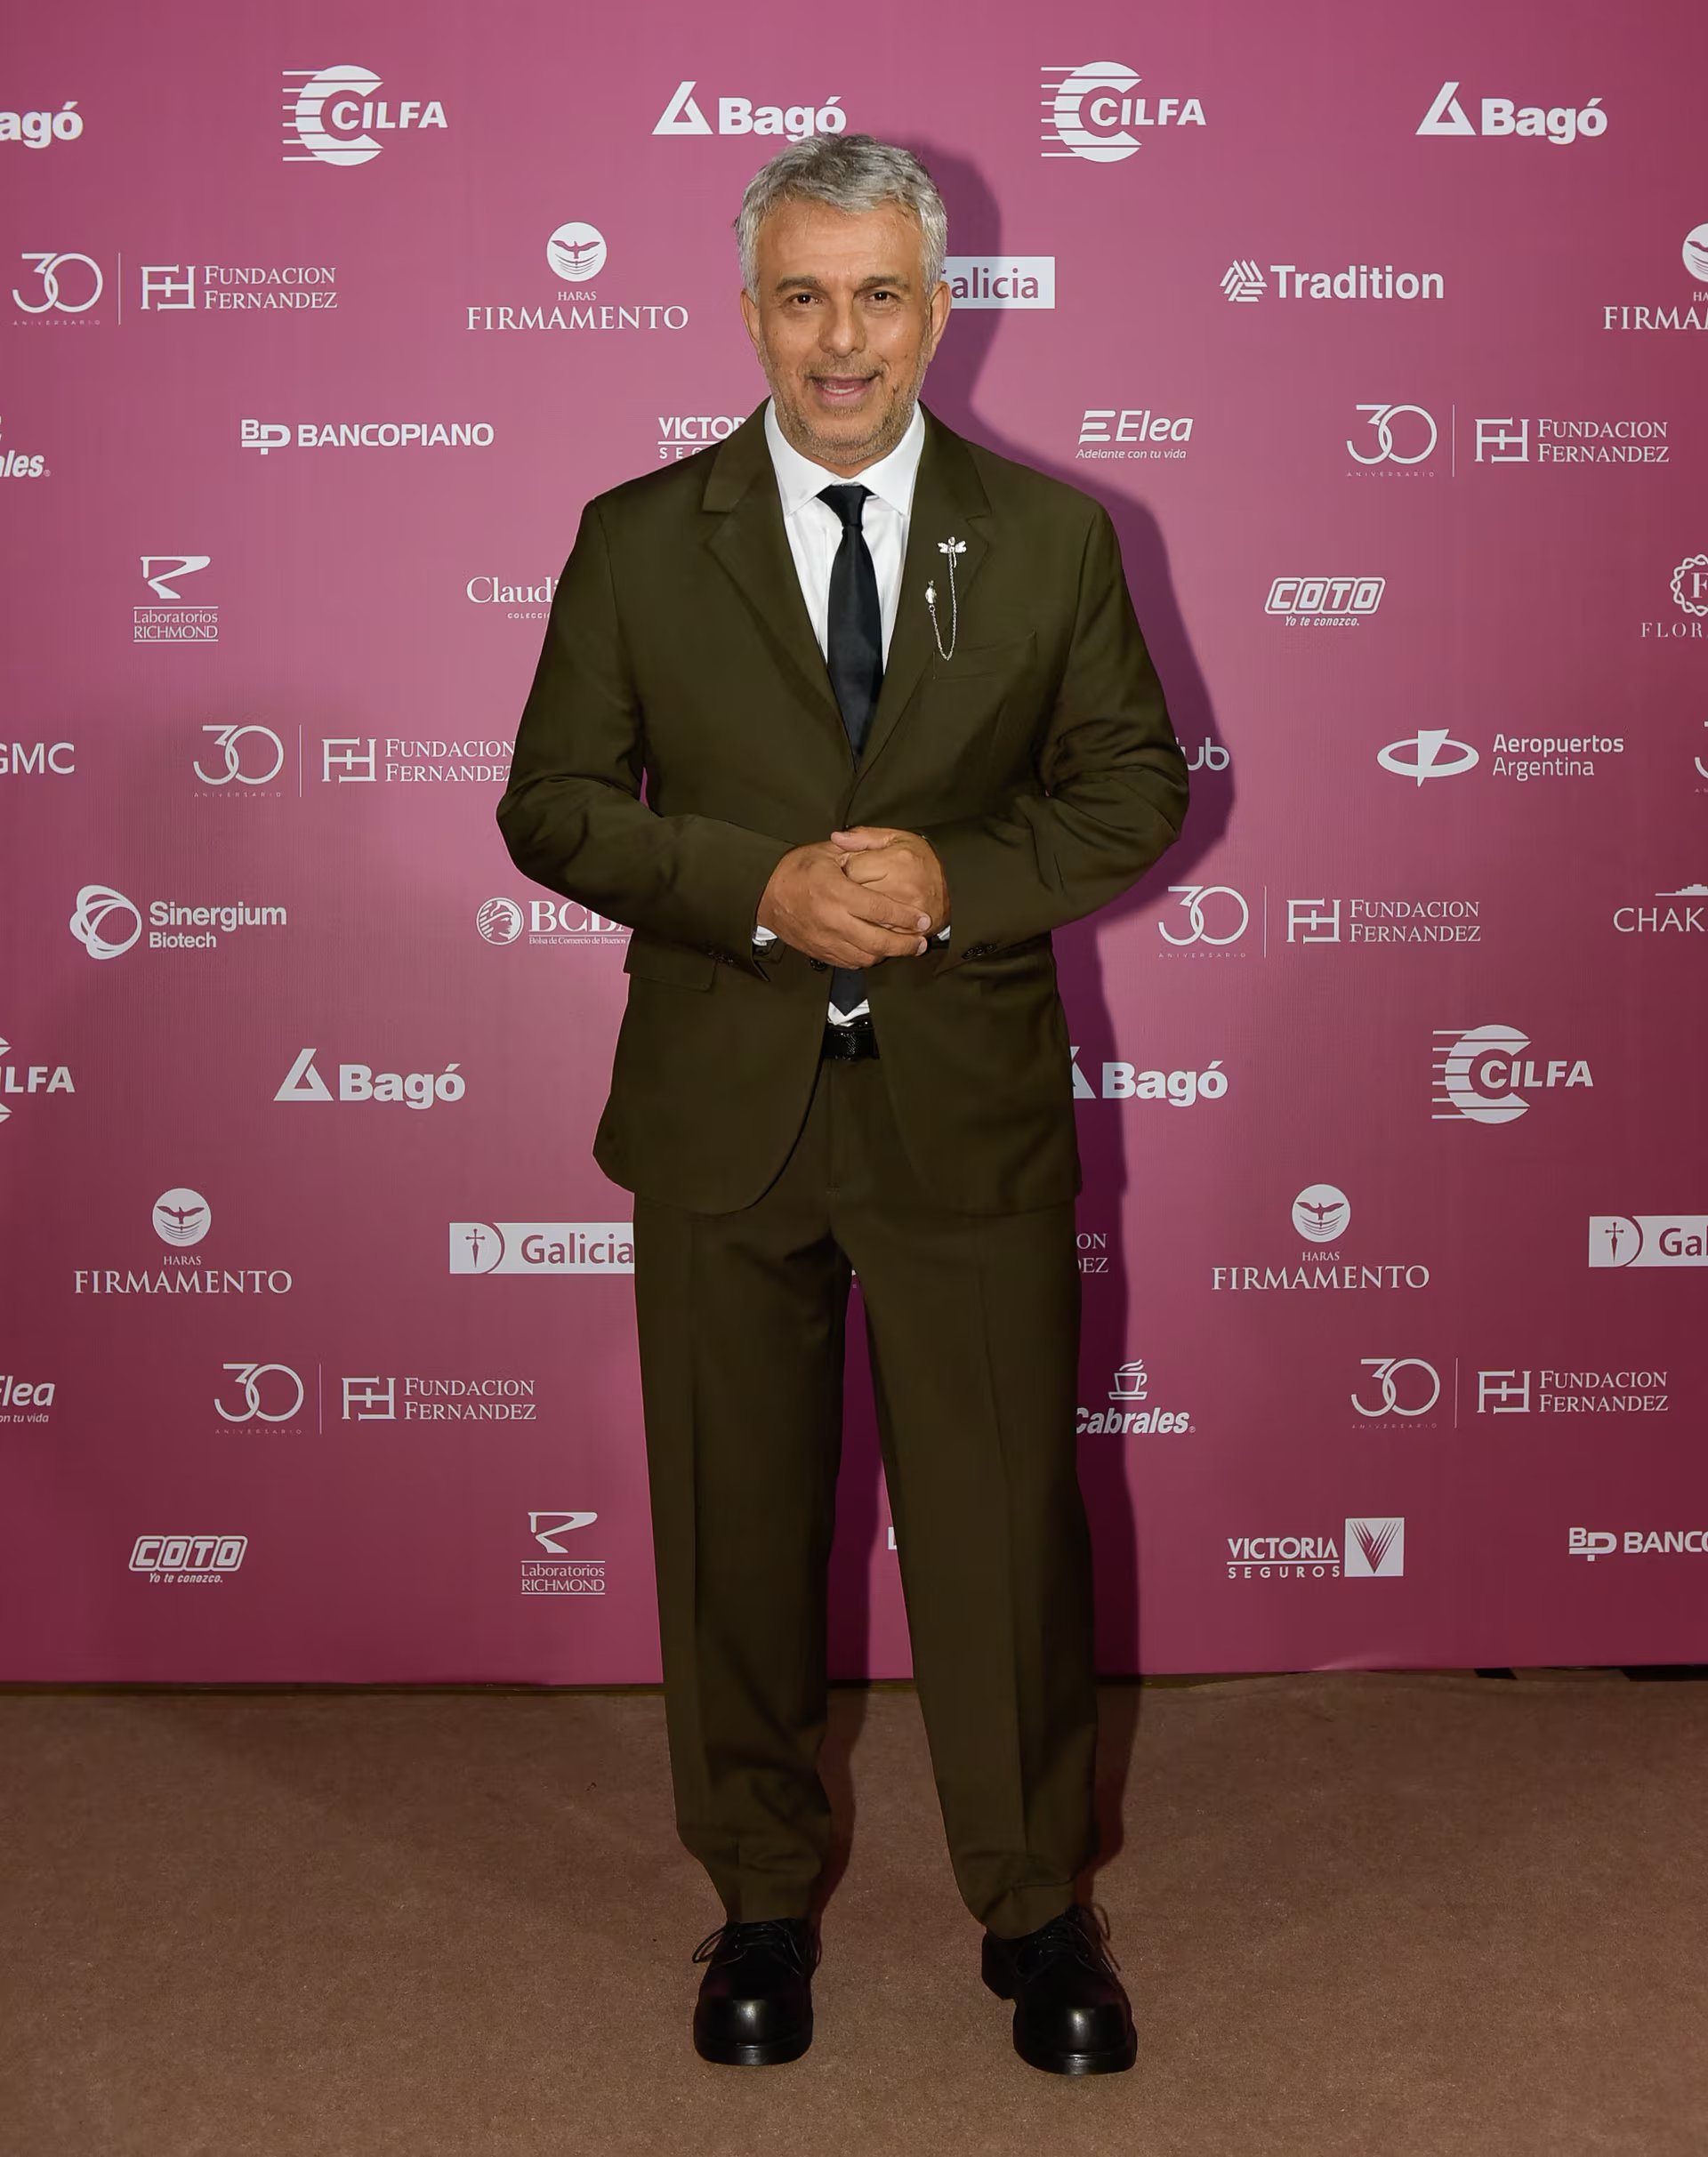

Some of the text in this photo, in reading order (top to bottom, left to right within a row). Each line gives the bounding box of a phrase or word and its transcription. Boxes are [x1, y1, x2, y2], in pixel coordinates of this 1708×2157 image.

[331, 101, 448, 131] CILFA
[719, 96, 847, 140] Bagó
[1090, 97, 1206, 127] CILFA
[1481, 97, 1607, 145] Bagó
[12, 253, 103, 314] 30
[205, 265, 336, 285] FUNDACION
[948, 262, 1041, 302] alicia
[1269, 265, 1444, 300] Tradition
[205, 290, 338, 310] FERNANDEZ
[558, 291, 597, 302] HARAS
[467, 305, 689, 330] FIRMAMENTO
[1603, 306, 1708, 330] FIRMA
[298, 423, 495, 447] BANCOPIANO
[1114, 410, 1194, 442] Elea
[1346, 404, 1438, 464] 30
[1538, 418, 1667, 439] FUNDACION
[1076, 448, 1187, 459] Adelante con tu vida
[1538, 443, 1669, 463] FERNANDEZ
[1264, 576, 1386, 615] COTO
[133, 608, 218, 624] Laboratorios
[1285, 616, 1360, 627] Yo te conozco.
[133, 624, 218, 639] RICHMOND
[1642, 622, 1703, 638] FLOR
[193, 725, 284, 785] 30
[383, 736, 514, 761] FUNDACION
[1493, 734, 1624, 760] Aeropuertos
[1493, 753, 1595, 782] Argentina
[149, 901, 287, 930] Sinergium
[528, 899, 624, 933] BCB
[1158, 885, 1249, 946] 30
[1350, 899, 1479, 918] FUNDACION
[1613, 907, 1705, 932] CHAK
[149, 931, 217, 948] Biotech
[528, 937, 626, 946] Bolsa de Comercio de Buenos
[1349, 923, 1481, 943] FERNANDEZ
[1102, 1060, 1229, 1107] Bagó
[1480, 1059, 1593, 1089] CILFA
[339, 1063, 466, 1110] Bagó
[164, 1255, 201, 1266] HARAS
[520, 1233, 634, 1267] Galicia
[1301, 1252, 1340, 1261] HARAS
[75, 1270, 293, 1294] FIRMAMENTO
[1213, 1265, 1430, 1290] FIRMAMENTO
[405, 1377, 535, 1396] FUNDACION
[1350, 1358, 1440, 1417] 30
[1540, 1370, 1667, 1388] FUNDACION
[214, 1363, 304, 1422] 30
[1539, 1394, 1668, 1413] FERNANDEZ
[12, 1414, 25, 1423] tu
[27, 1413, 49, 1423] vida
[404, 1401, 536, 1420] FERNANDEZ
[128, 1535, 248, 1572] COTO
[1228, 1537, 1339, 1559] VICTORIA
[149, 1573, 223, 1583] Yo te conozco.
[521, 1563, 605, 1577] Laboratorios
[1227, 1563, 1340, 1579] SEGUROS
[521, 1579, 605, 1592] RICHMOND
